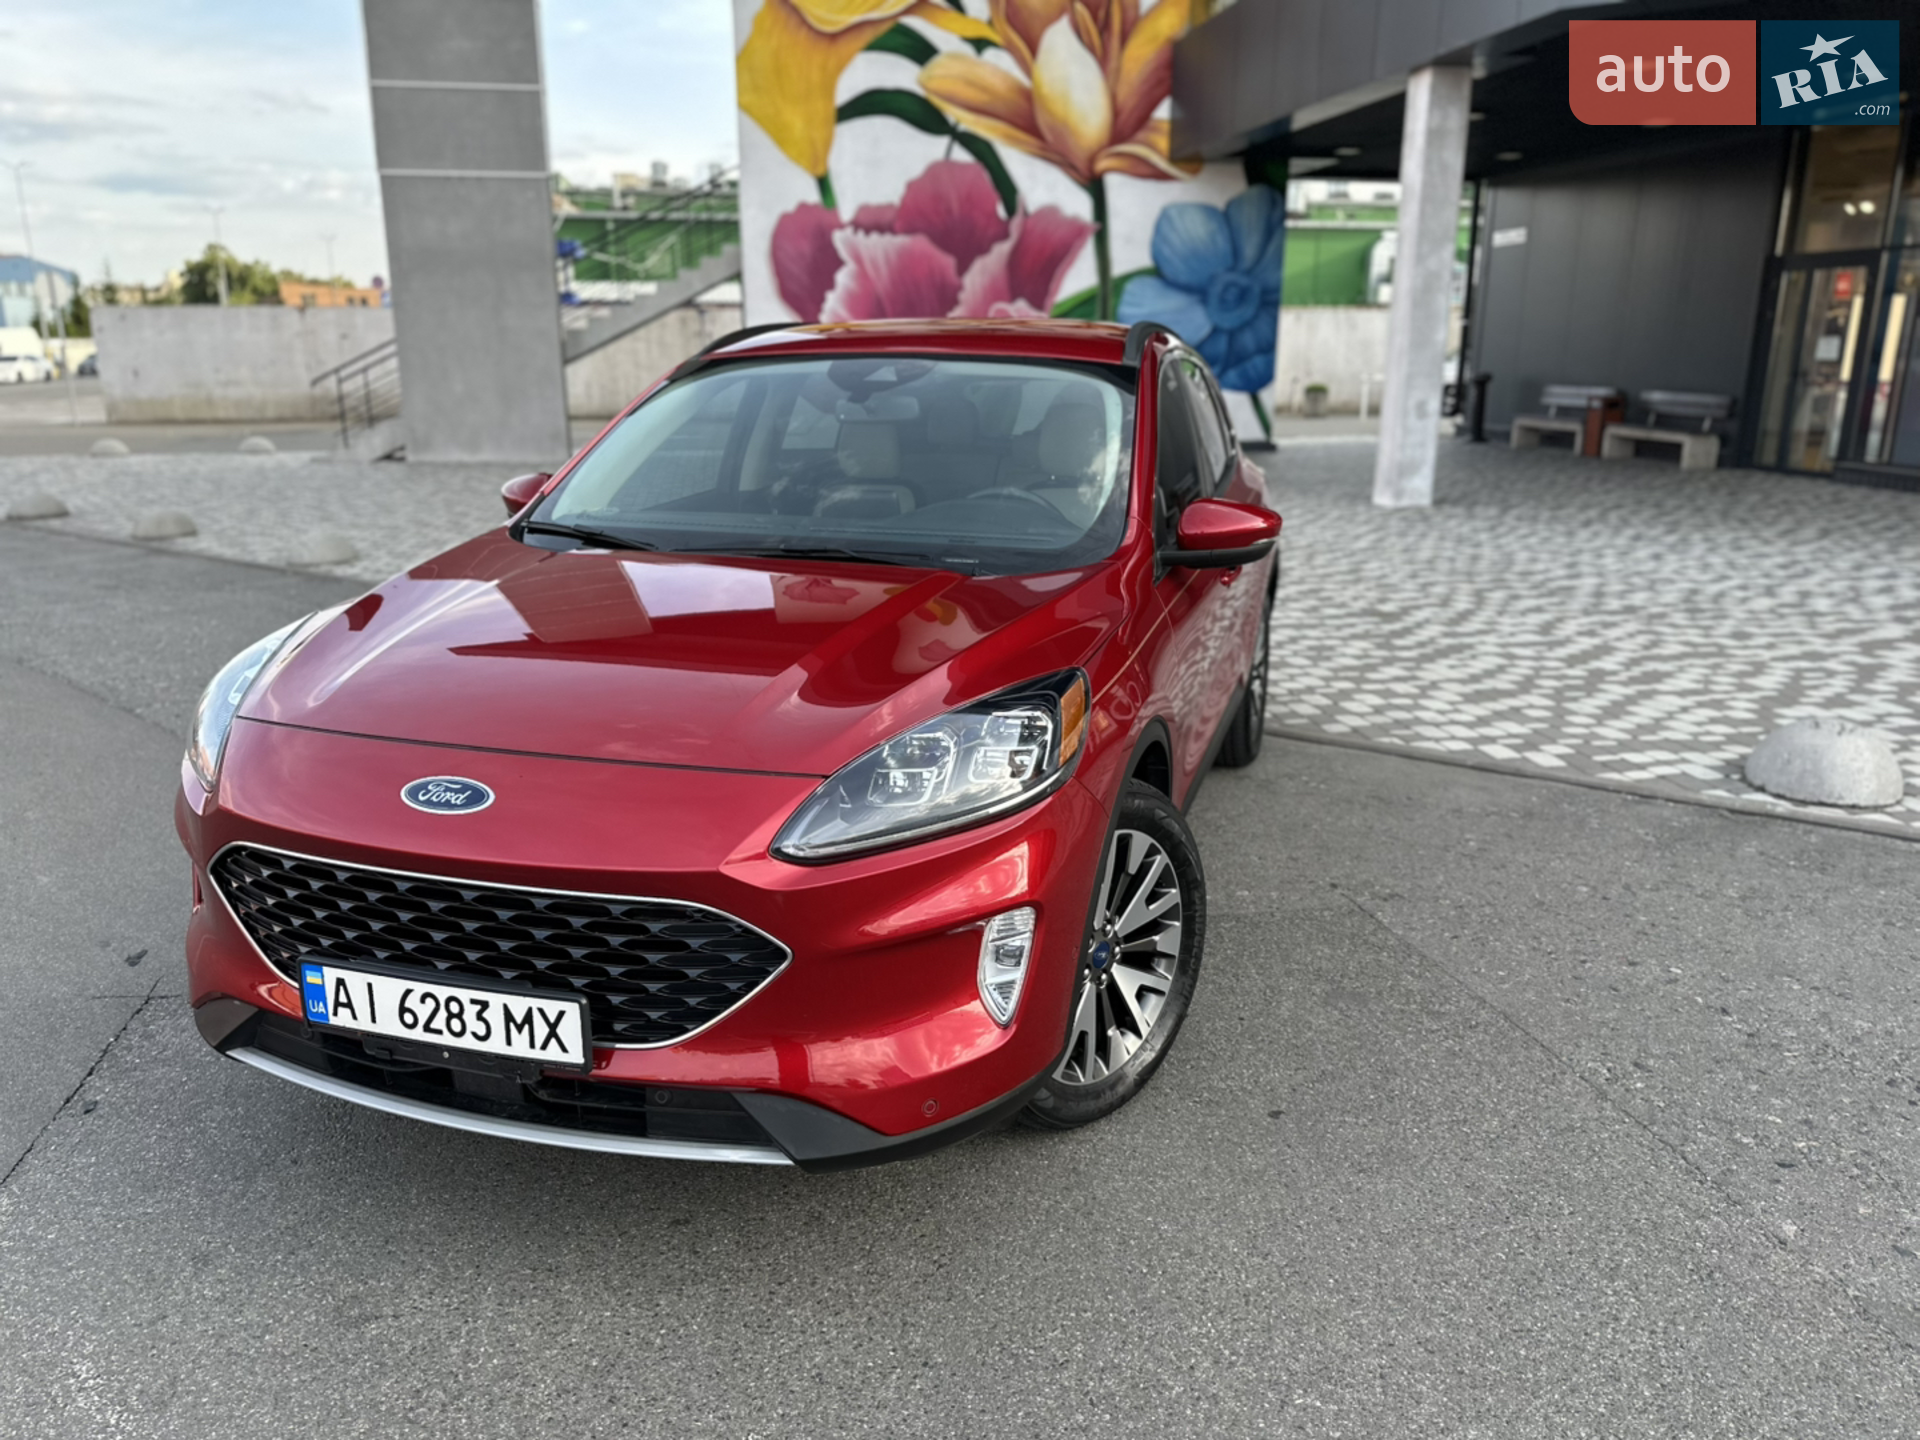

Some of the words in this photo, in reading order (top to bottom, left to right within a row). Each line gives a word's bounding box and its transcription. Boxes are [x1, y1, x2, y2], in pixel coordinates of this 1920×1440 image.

[418, 781, 472, 805] Ford
[308, 999, 327, 1015] UA
[332, 977, 377, 1024] AI
[398, 988, 492, 1042] 6283
[502, 1002, 570, 1054] MX
